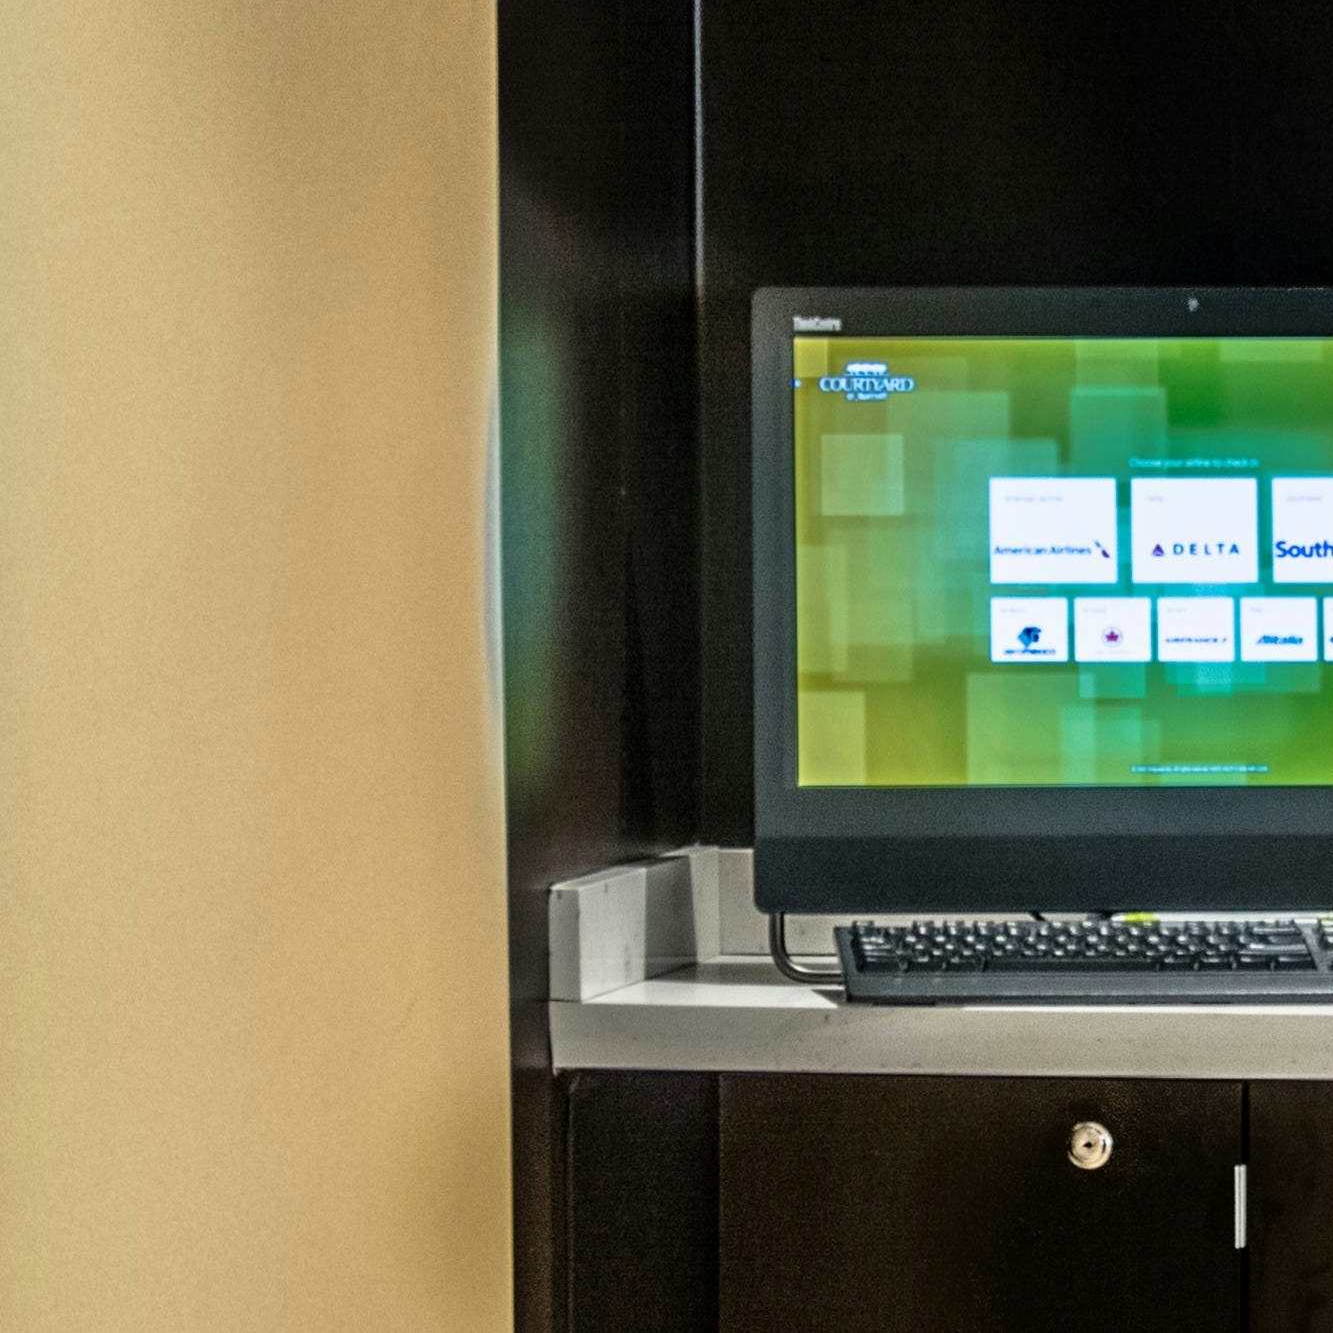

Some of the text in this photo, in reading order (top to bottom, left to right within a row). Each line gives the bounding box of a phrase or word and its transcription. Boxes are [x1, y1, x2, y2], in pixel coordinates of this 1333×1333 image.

[819, 377, 916, 392] COURTYARD
[994, 544, 1092, 556] American Airlines
[1172, 543, 1240, 556] DELTA
